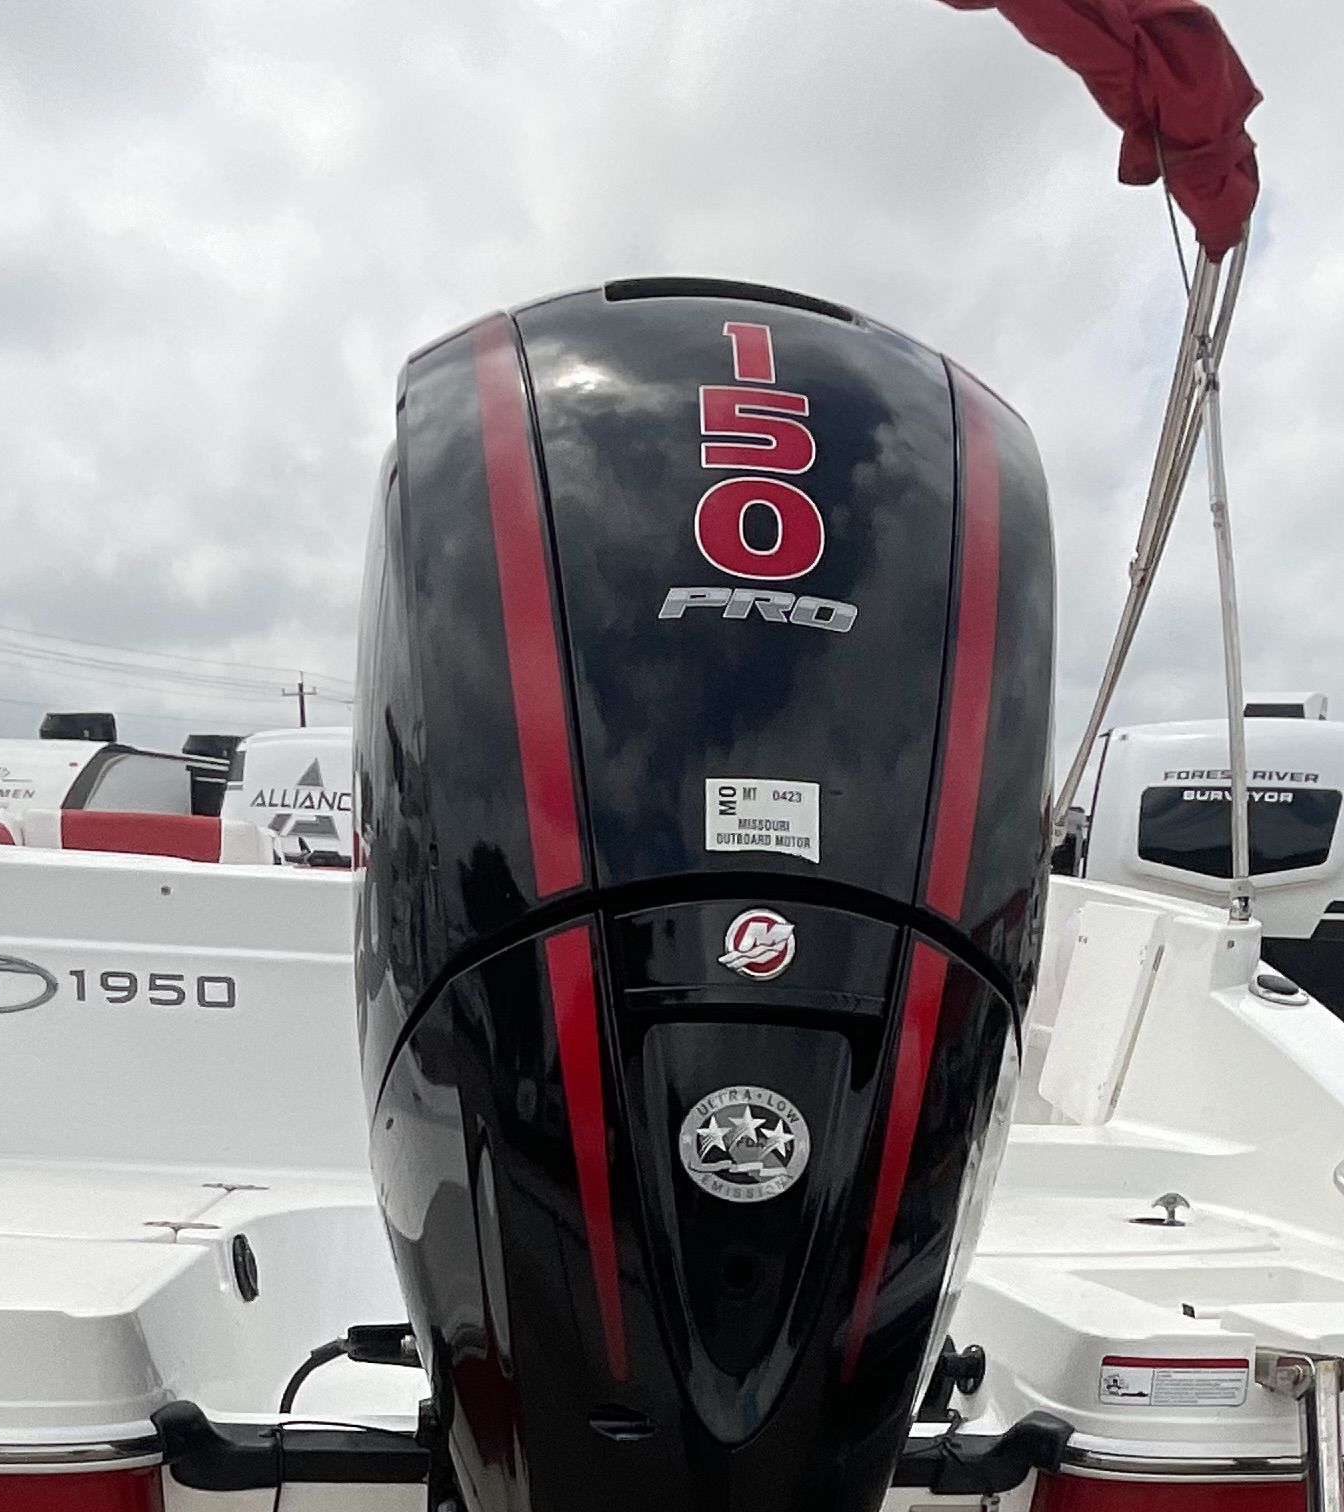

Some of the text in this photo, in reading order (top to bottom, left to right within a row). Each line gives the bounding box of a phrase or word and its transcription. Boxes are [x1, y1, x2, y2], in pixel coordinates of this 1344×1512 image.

[694, 320, 826, 581] 150
[657, 586, 860, 633] PRO
[1162, 768, 1320, 784] FORES RIVER
[249, 787, 353, 813] ALLIANC
[718, 785, 737, 816] MO
[742, 786, 758, 801] MT
[1182, 789, 1294, 803] SURVYOR
[737, 818, 791, 832] MISSOURI
[716, 832, 811, 849] OUTBOARD MOTOR
[69, 968, 236, 1009] 1950
